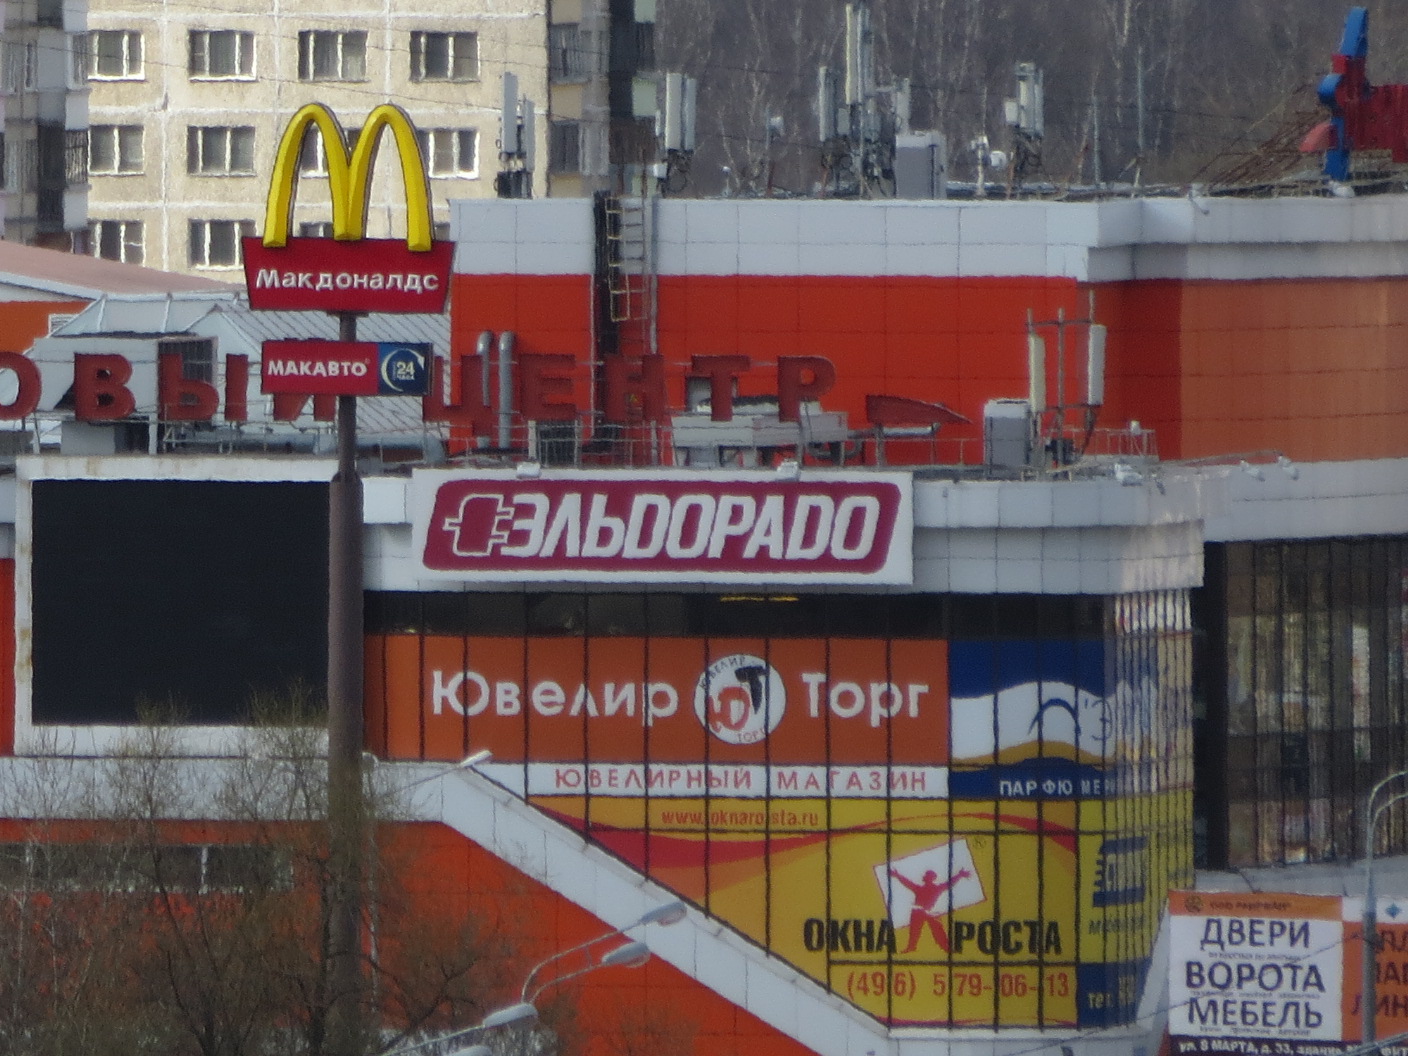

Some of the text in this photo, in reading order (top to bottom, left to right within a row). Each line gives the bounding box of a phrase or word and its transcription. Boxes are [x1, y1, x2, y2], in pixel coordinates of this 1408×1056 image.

[255, 268, 440, 292] Макдоналдс
[267, 359, 368, 377] МАКАВТО
[396, 360, 415, 375] 24
[423, 352, 836, 436] ЦЕНТР
[430, 670, 930, 726] Ювелир Торг
[554, 767, 927, 792] ЮВЕЛИРНЫЙ МАГАЗИН
[803, 917, 897, 955] ОКНА
[954, 919, 1063, 955] РОСТА
[1200, 918, 1311, 951] ДВЕРИ
[847, 970, 917, 1001] (496)
[1185, 961, 1326, 993] ВОРОТА
[1188, 996, 1323, 1029] МЕБЕЛЬ
